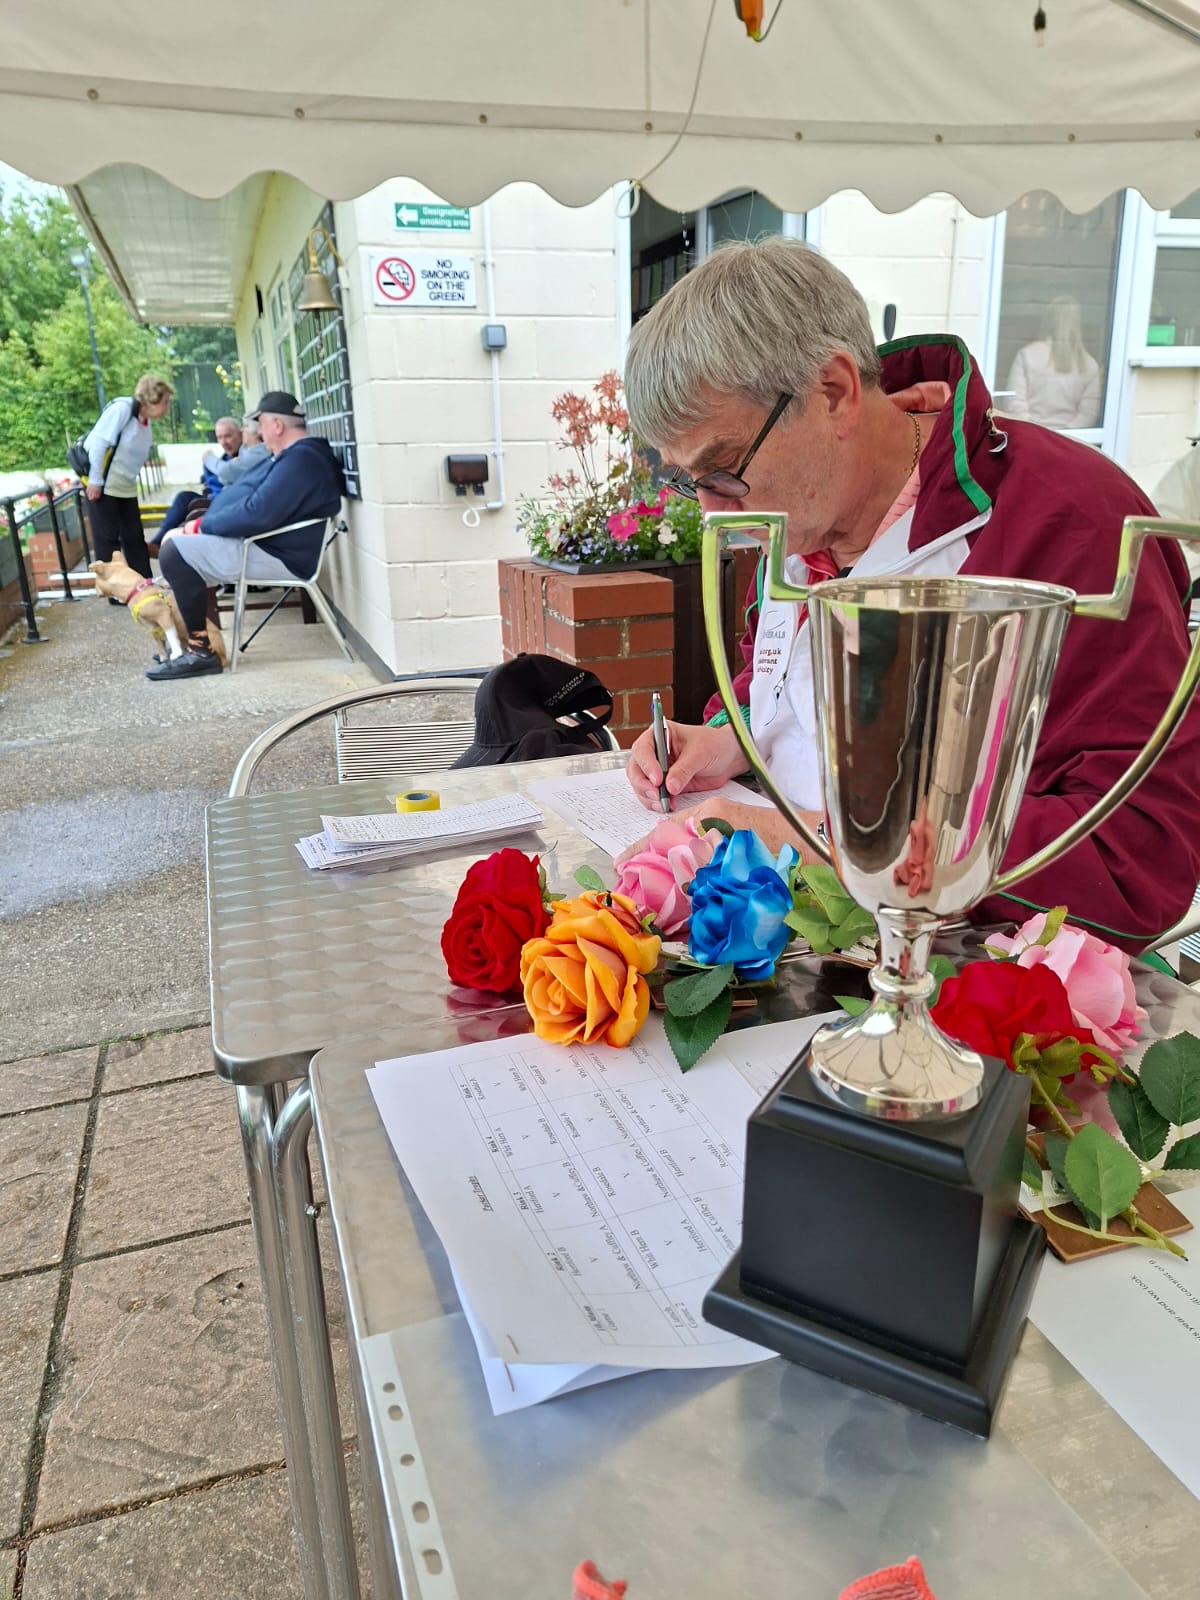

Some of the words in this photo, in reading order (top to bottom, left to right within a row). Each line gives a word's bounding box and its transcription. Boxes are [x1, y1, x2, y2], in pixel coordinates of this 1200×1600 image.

[436, 259, 453, 269] NO
[420, 269, 470, 280] SMOKING
[426, 280, 442, 290] ON
[446, 281, 465, 290] THE
[428, 291, 465, 302] GREEN
[705, 1143, 728, 1167] Rosedale
[717, 1142, 732, 1156] Meal
[594, 1171, 616, 1197] Rosedale
[524, 1190, 544, 1213] Hertford
[696, 1202, 720, 1226] Cuffley
[683, 1225, 707, 1251] Hertford
[1163, 1272, 1192, 1297] consist
[1147, 1290, 1160, 1301] we
[1157, 1301, 1176, 1315] and
